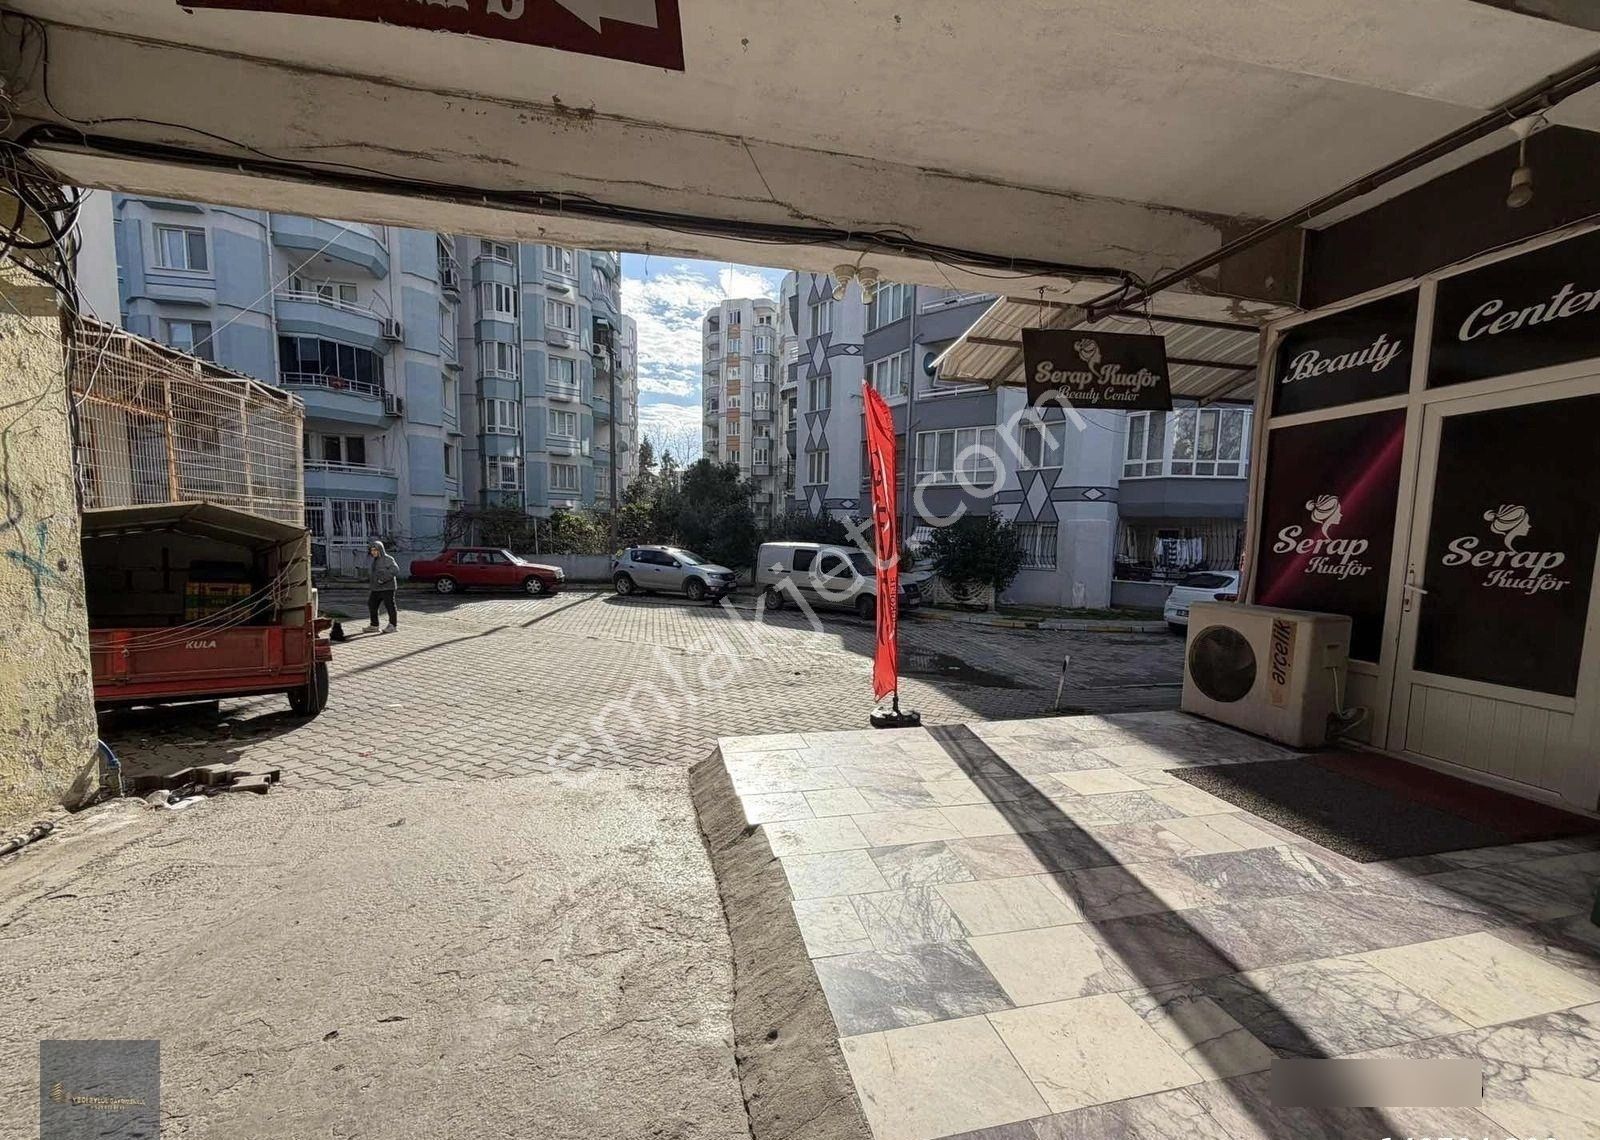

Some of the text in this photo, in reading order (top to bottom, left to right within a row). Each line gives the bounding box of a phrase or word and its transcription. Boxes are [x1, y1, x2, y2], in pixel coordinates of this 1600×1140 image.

[1282, 333, 1402, 384] Beauty
[1034, 361, 1160, 392] Serap Kuaför
[1056, 385, 1140, 403] Beauty Center
[1273, 525, 1369, 565] Serap
[1441, 536, 1566, 579] Serap
[1304, 556, 1373, 580] Kuaför
[1482, 569, 1571, 595] Kuaför
[185, 640, 217, 649] KULA
[1271, 620, 1292, 686] arçelik
